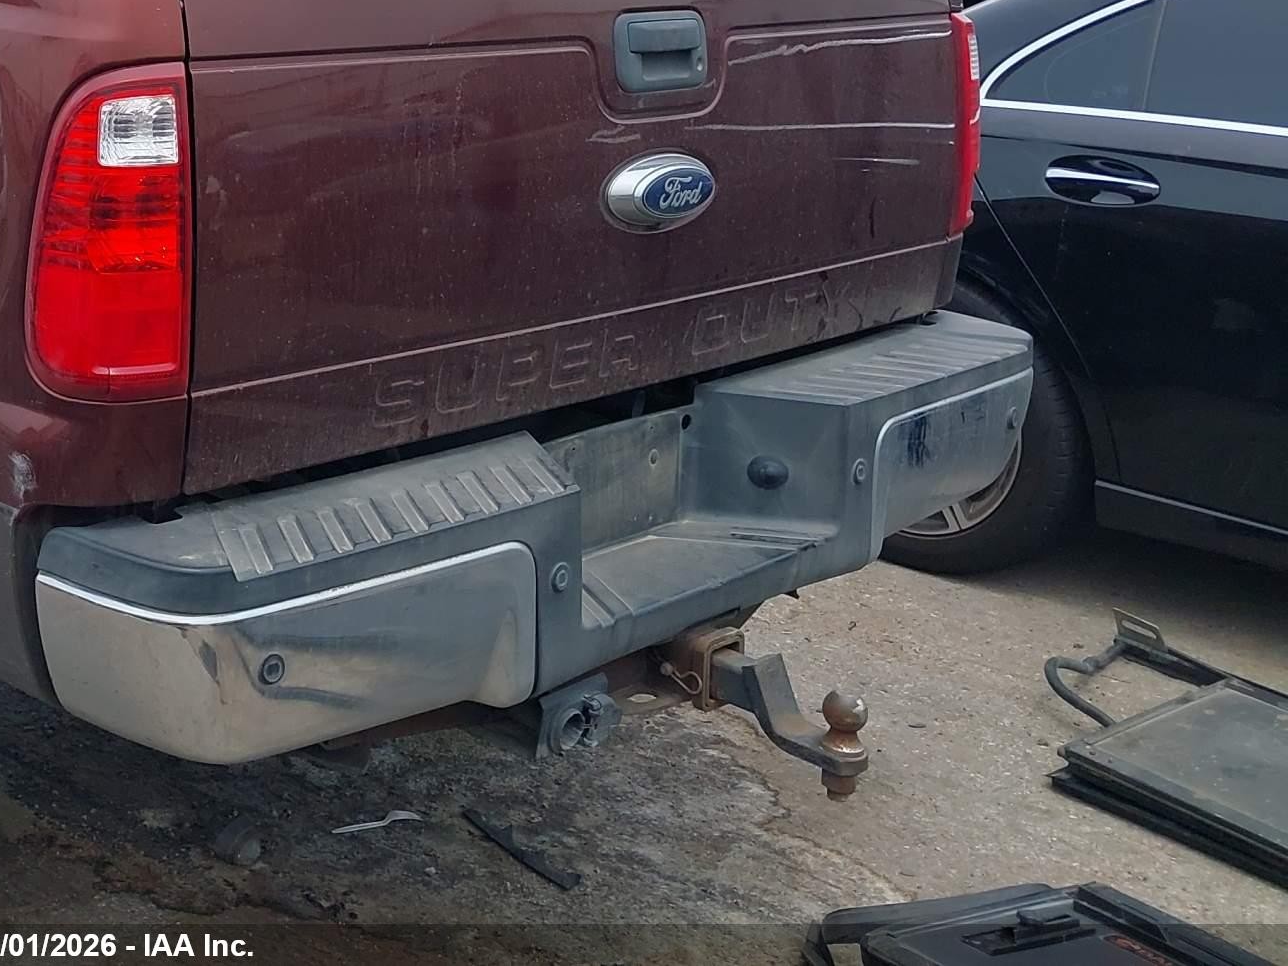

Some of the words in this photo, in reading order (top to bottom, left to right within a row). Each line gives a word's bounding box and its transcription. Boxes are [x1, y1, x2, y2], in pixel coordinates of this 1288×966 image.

[659, 176, 703, 210] Ford
[370, 326, 642, 428] SUPER
[690, 281, 853, 356] DUTY
